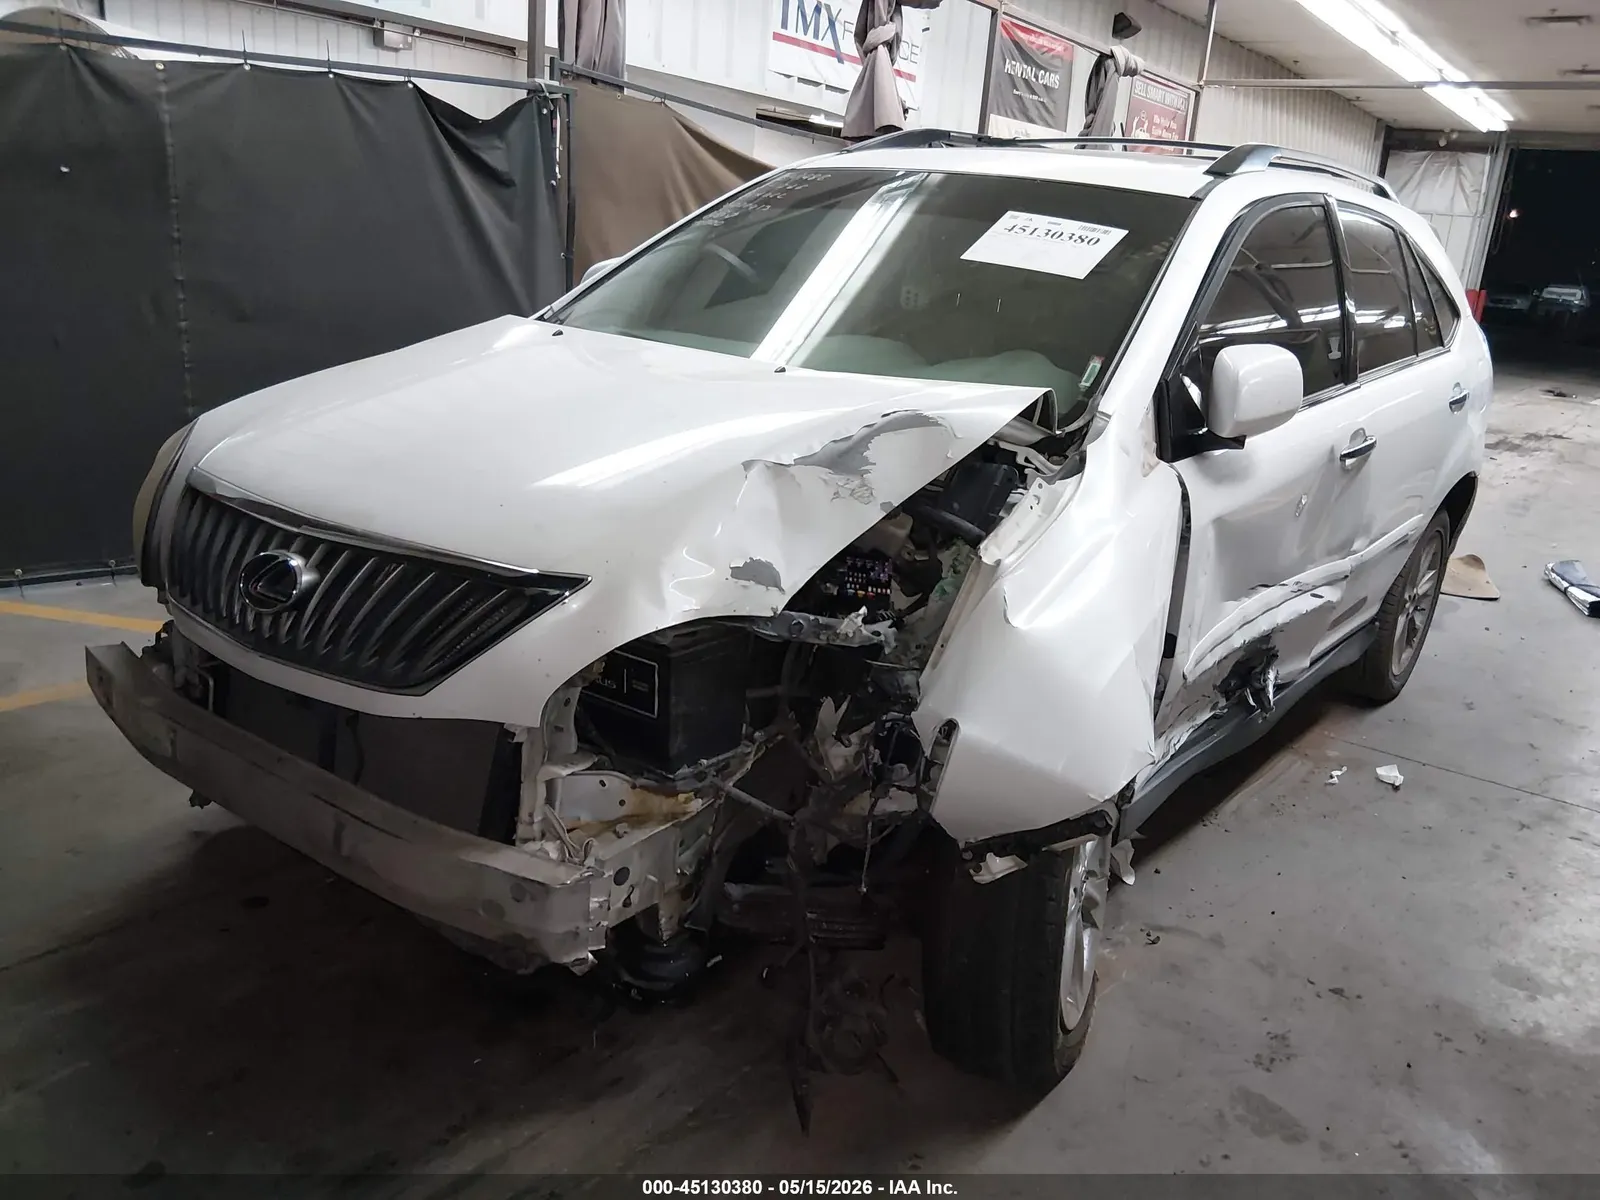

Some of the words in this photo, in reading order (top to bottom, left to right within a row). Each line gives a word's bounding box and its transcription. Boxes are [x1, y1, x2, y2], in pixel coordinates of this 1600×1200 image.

[1004, 58, 1036, 82] RENTAL
[1038, 70, 1060, 89] CARS
[1134, 80, 1147, 97] SELL
[1004, 224, 1101, 246] 45130380
